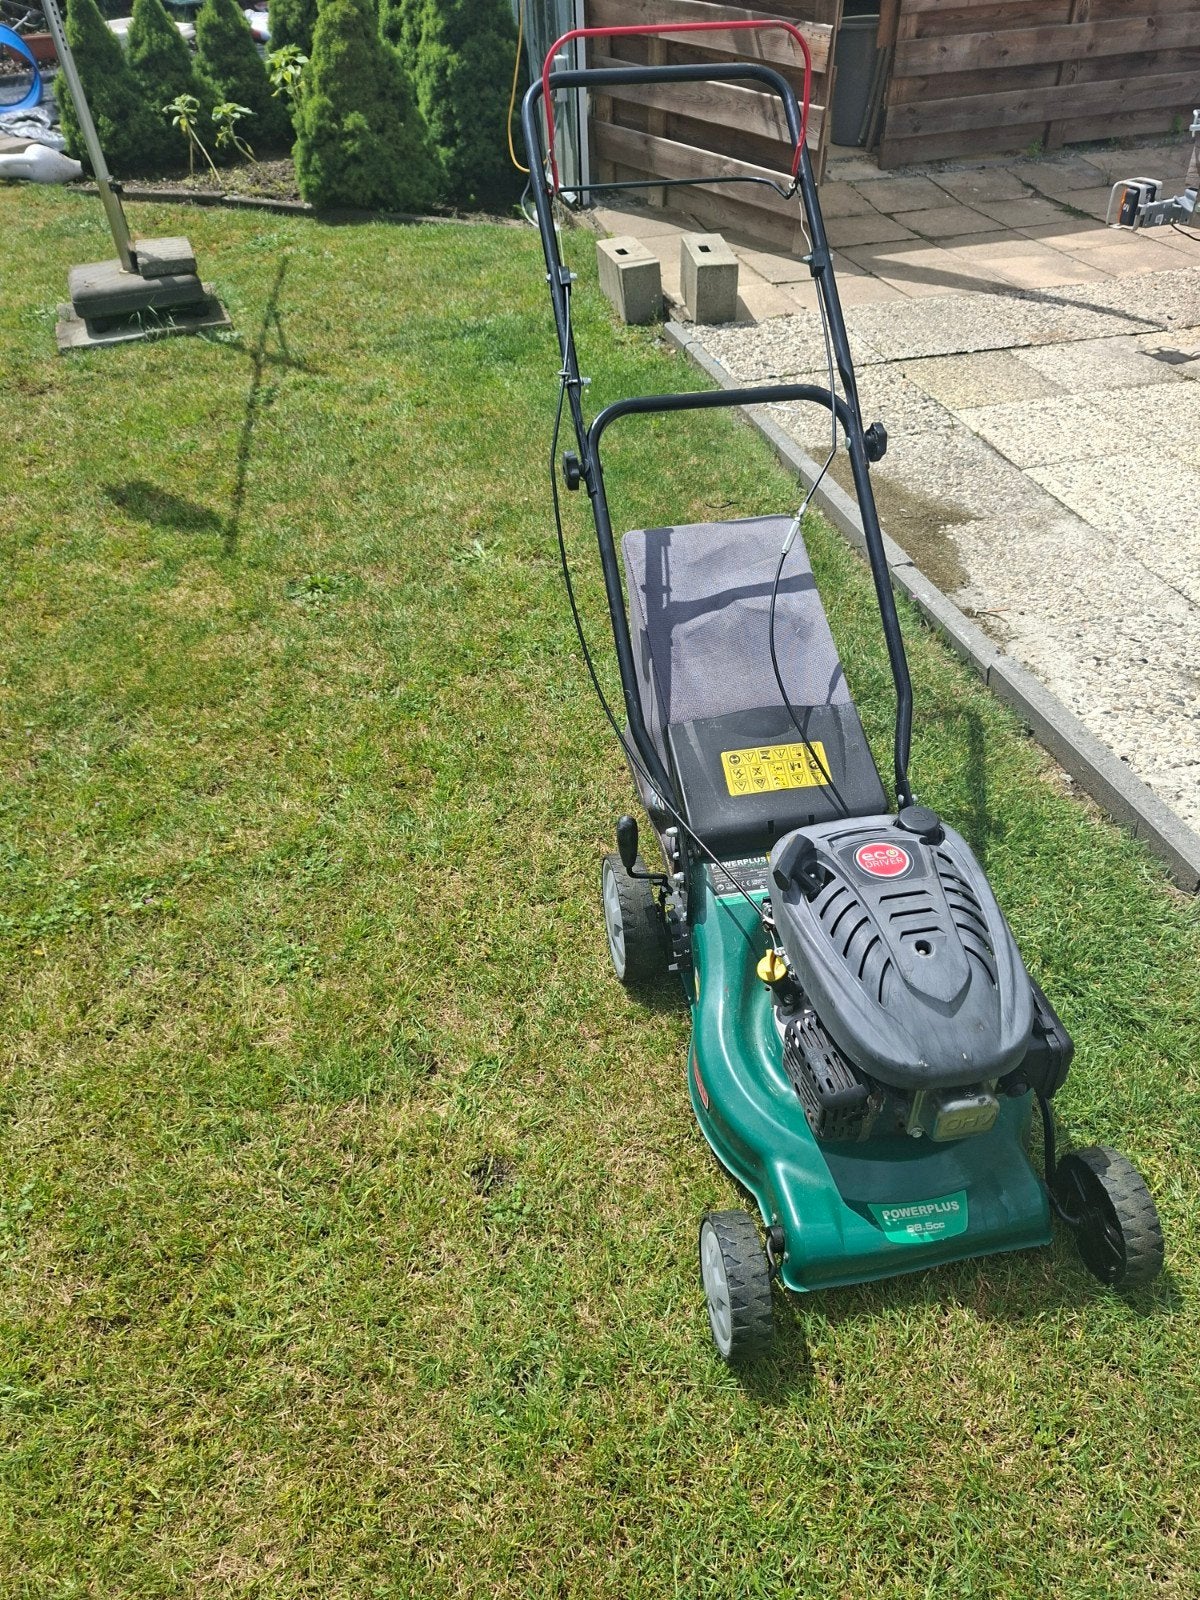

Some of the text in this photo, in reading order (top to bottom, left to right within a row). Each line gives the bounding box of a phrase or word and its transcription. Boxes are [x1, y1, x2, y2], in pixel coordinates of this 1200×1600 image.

[862, 849, 899, 861] eco
[865, 857, 904, 868] DRIVER
[882, 1200, 960, 1220] POWERPLUS
